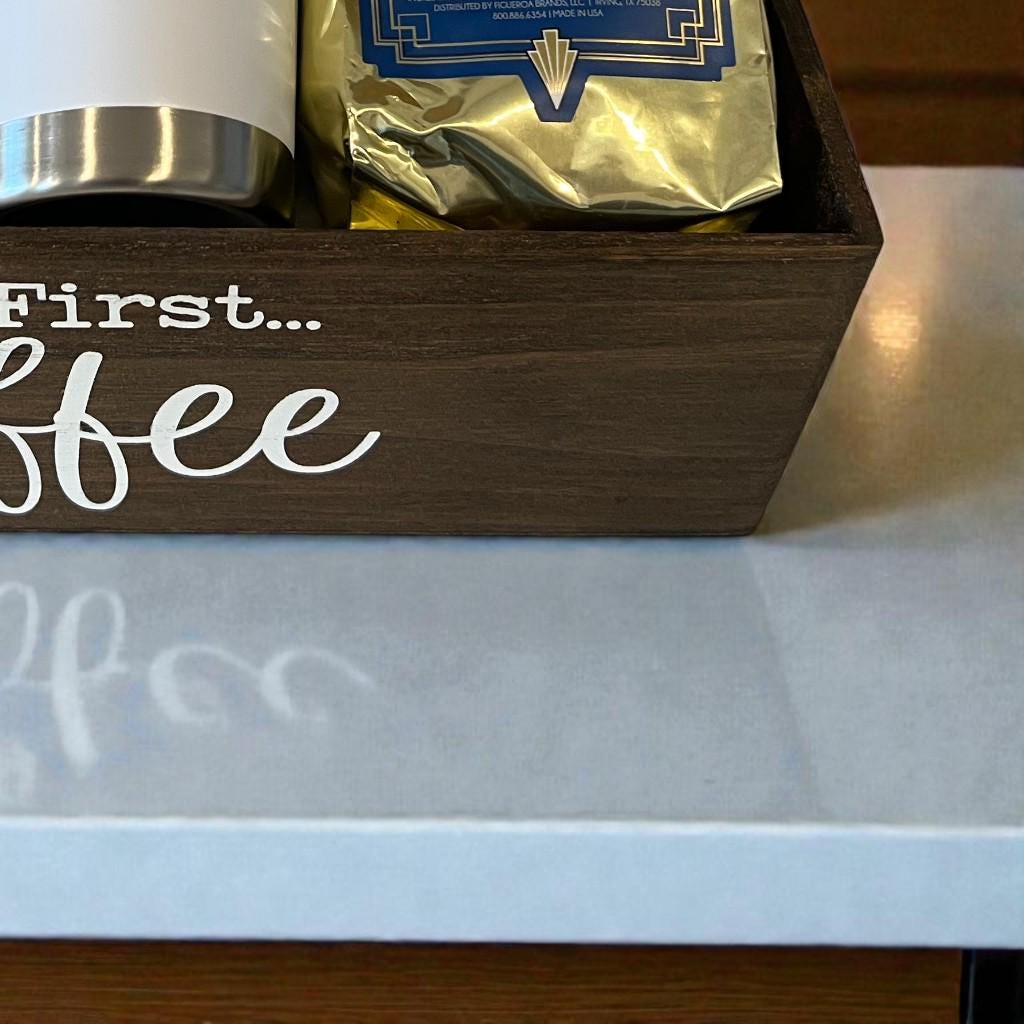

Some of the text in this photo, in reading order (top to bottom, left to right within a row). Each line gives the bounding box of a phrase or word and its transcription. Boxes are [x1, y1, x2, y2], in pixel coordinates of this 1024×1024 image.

[433, 2, 481, 12] DISTRIBUTED
[481, 1, 493, 10] BY
[552, 9, 576, 18] MADE
[576, 9, 586, 17] IN
[586, 8, 604, 17] USA
